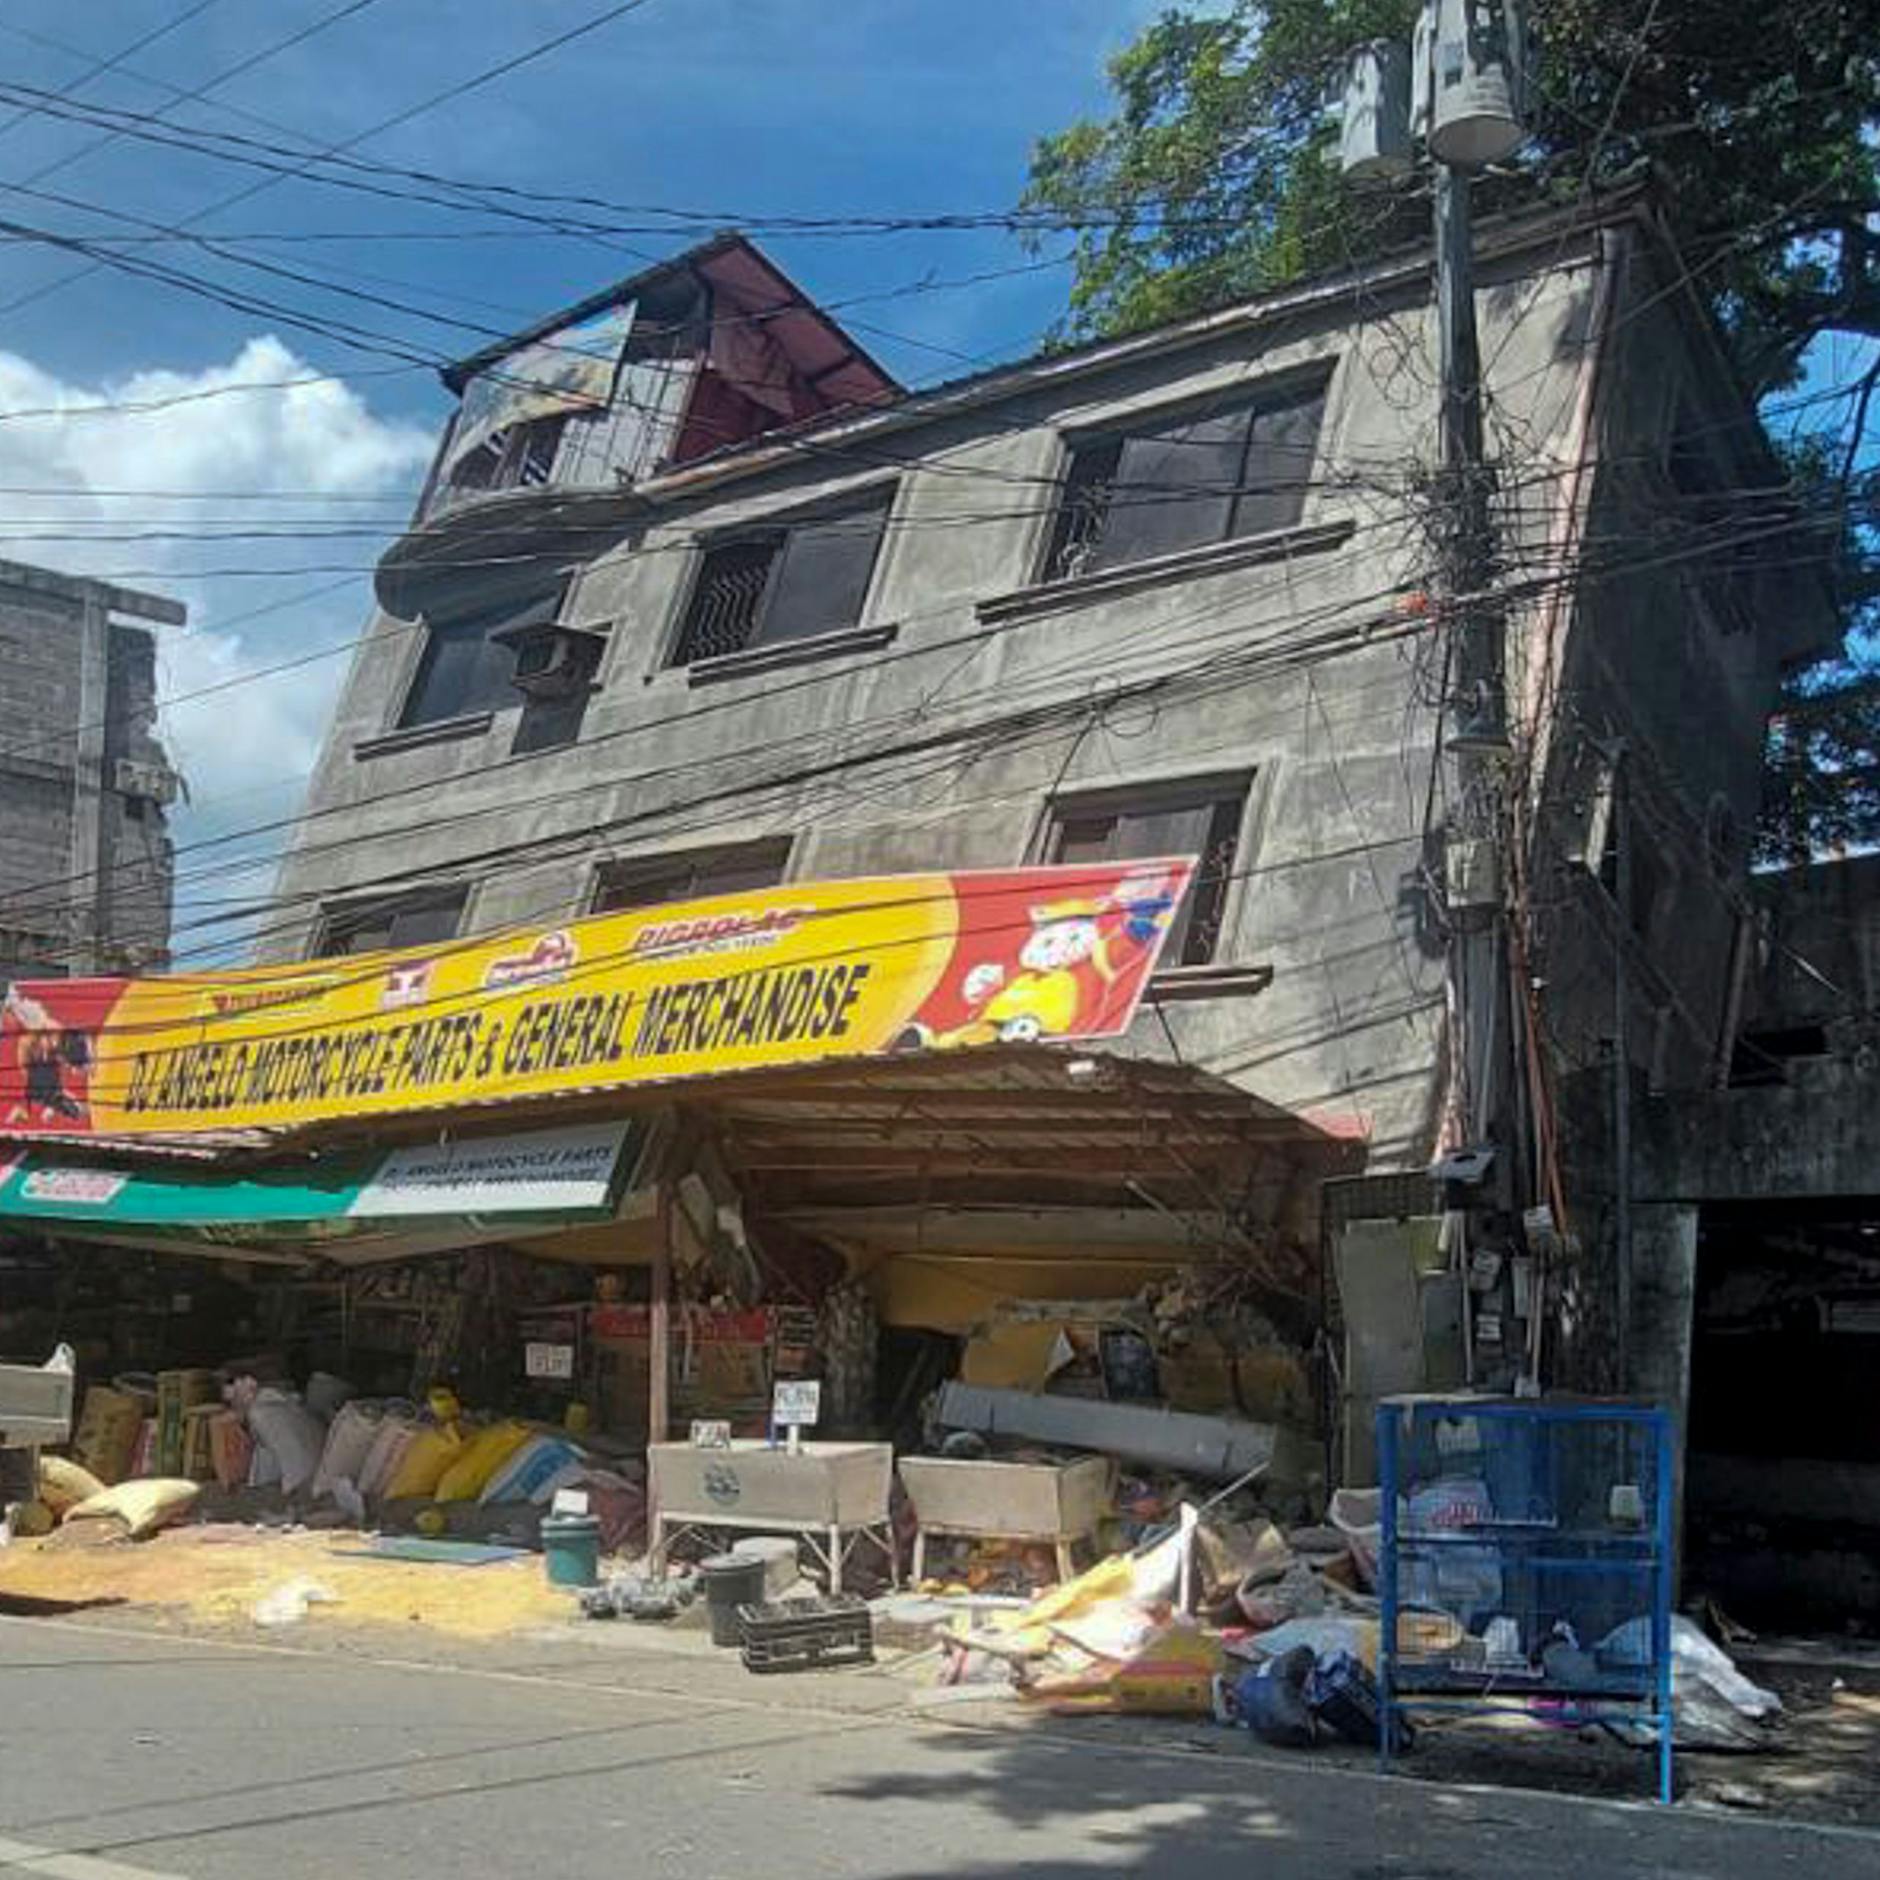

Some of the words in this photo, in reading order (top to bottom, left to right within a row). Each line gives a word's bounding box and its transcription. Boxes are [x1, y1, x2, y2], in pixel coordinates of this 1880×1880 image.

[157, 1042, 248, 1108] ANGELO
[245, 1026, 402, 1103] MOTORCYCLE
[391, 1015, 482, 1089] PARTS
[476, 1021, 502, 1078] &
[503, 992, 633, 1075] GENERAL
[632, 964, 871, 1057] MERCHANDISE
